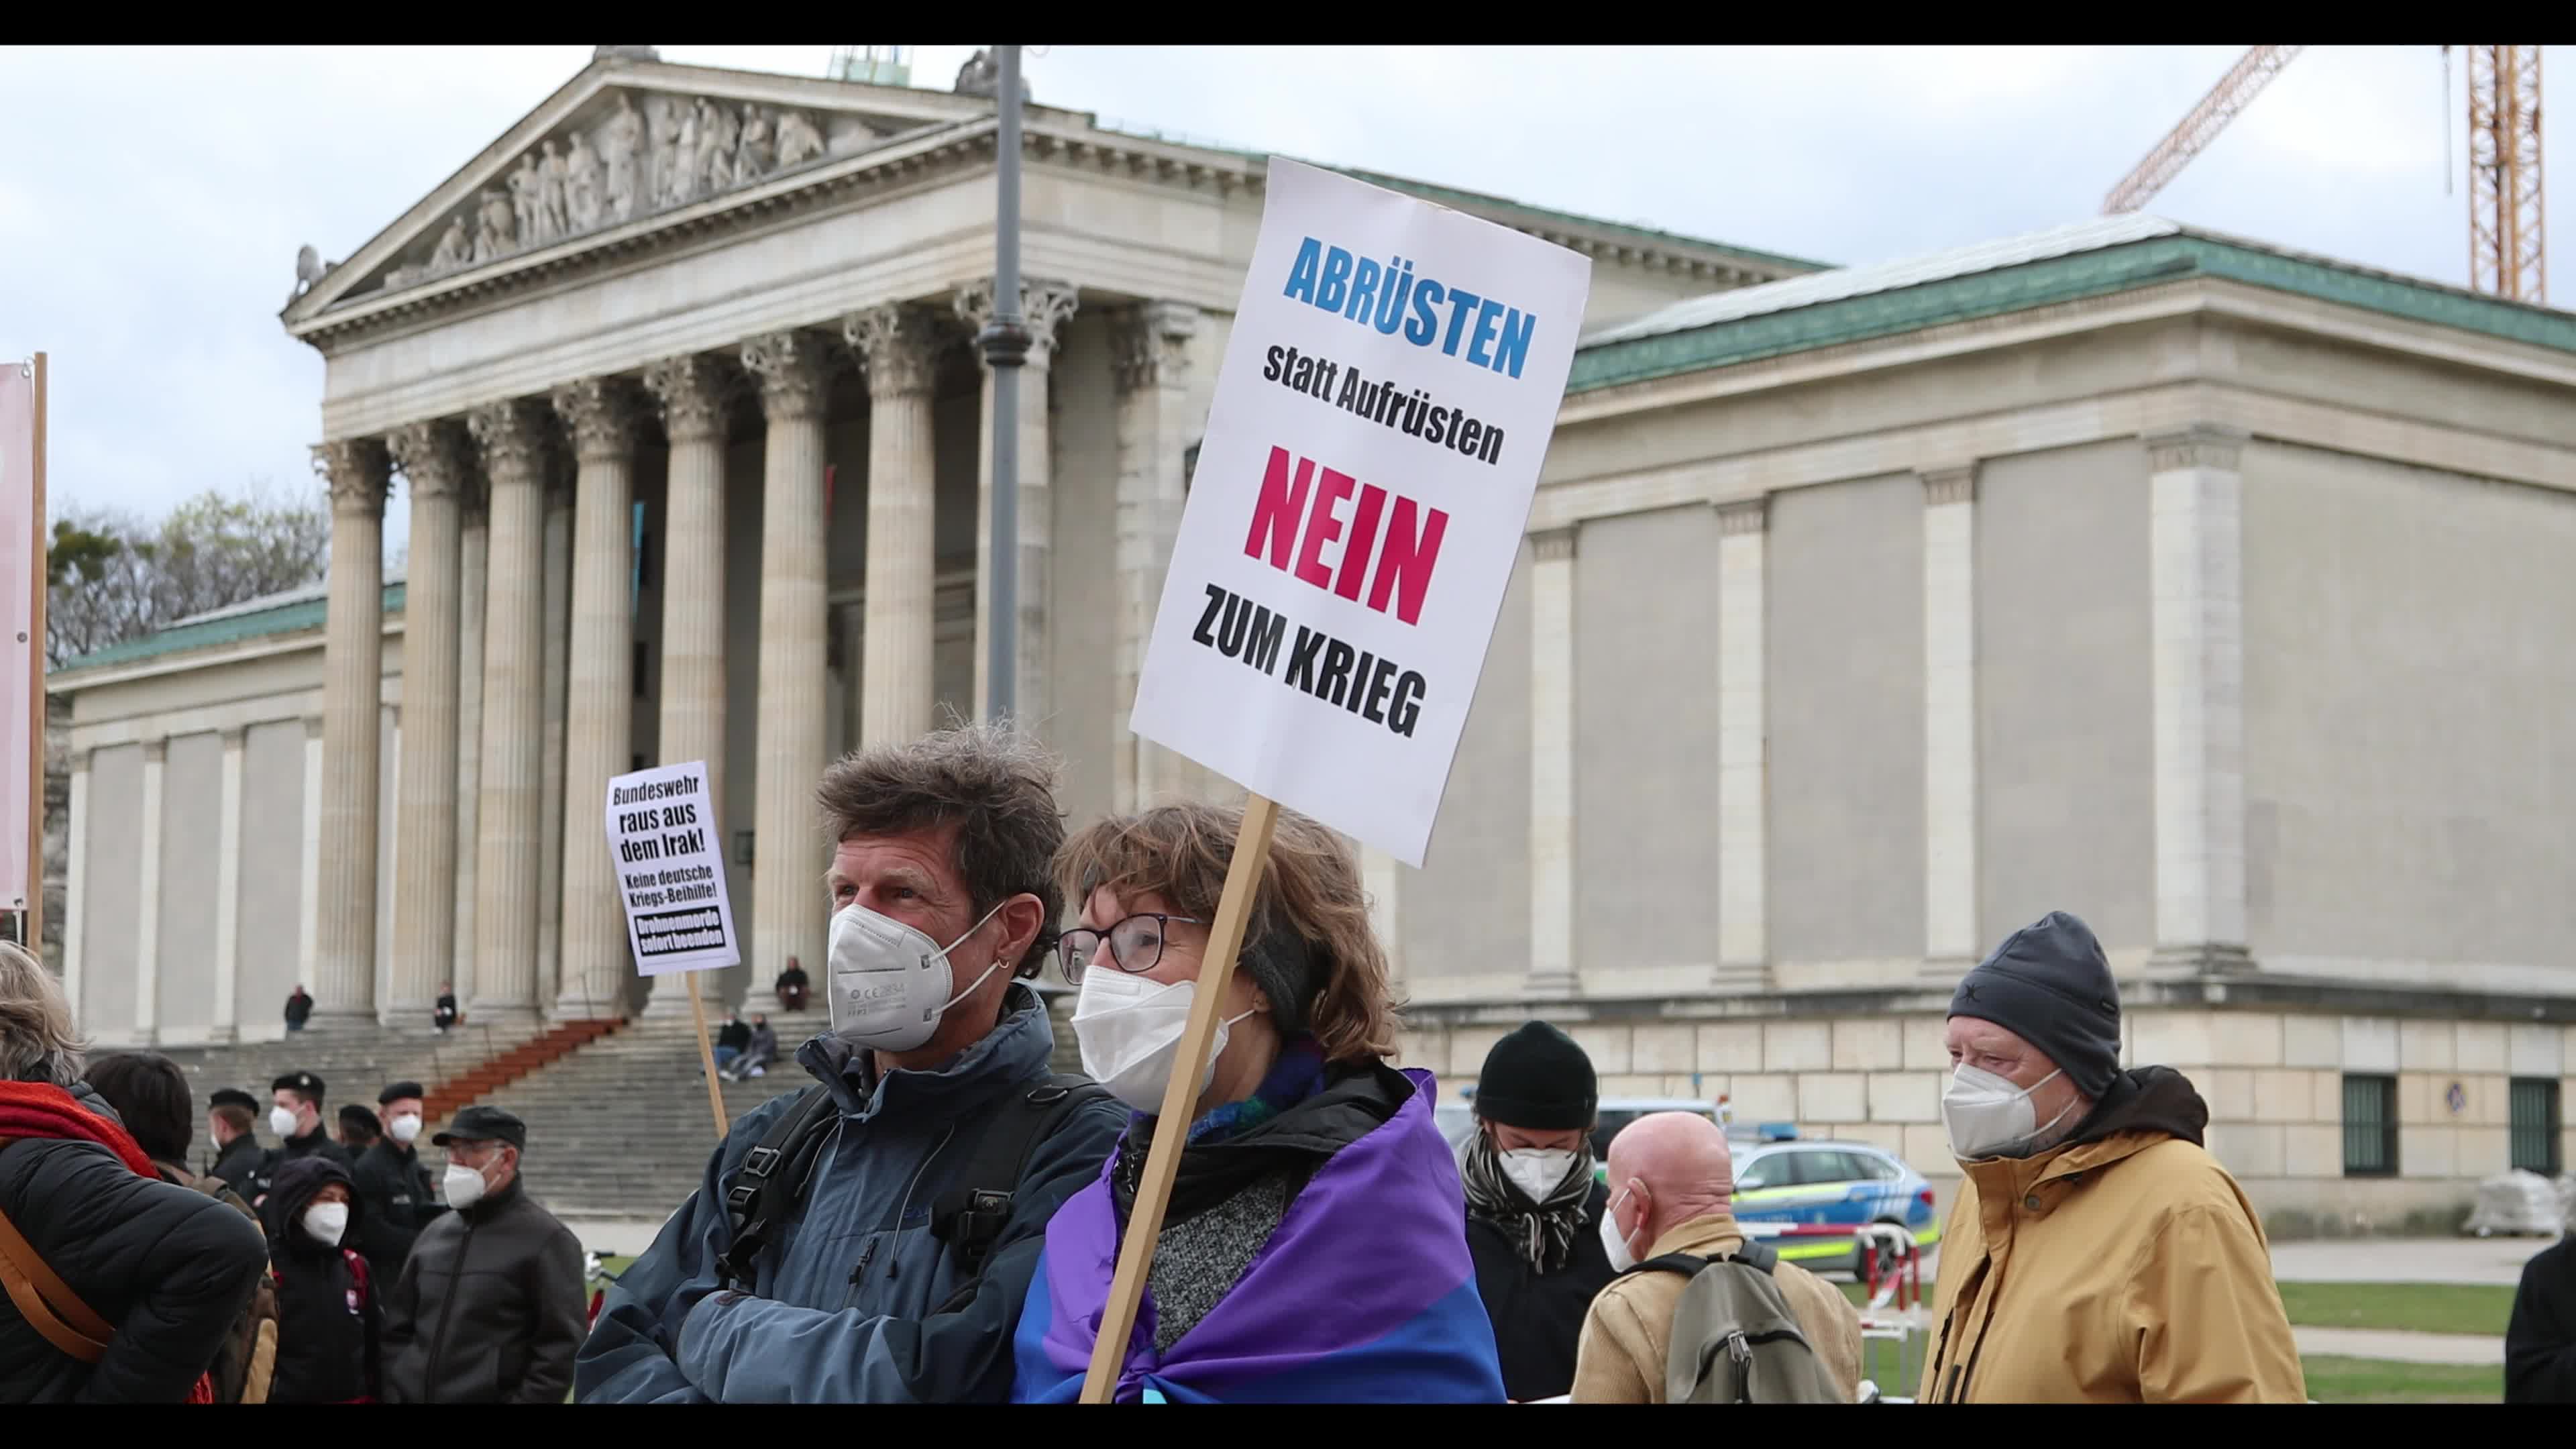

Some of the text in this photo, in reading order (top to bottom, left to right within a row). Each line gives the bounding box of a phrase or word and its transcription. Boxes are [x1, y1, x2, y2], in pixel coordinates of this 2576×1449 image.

[1283, 237, 1536, 379] ABRÜSTEN
[1264, 345, 1504, 466] statt Aufrüsten
[1244, 445, 1449, 626] NEIN
[1193, 583, 1426, 738] ZUM KRIEG
[613, 775, 699, 806] Bundeswehr
[619, 803, 697, 835] raus aus
[620, 827, 706, 863] dem Irak!
[625, 865, 713, 890] Keine deutsche
[629, 881, 717, 908] Kriegs-Beihilfe!
[637, 909, 720, 934] Drohnenmorde
[640, 928, 723, 953] sofort beenden
